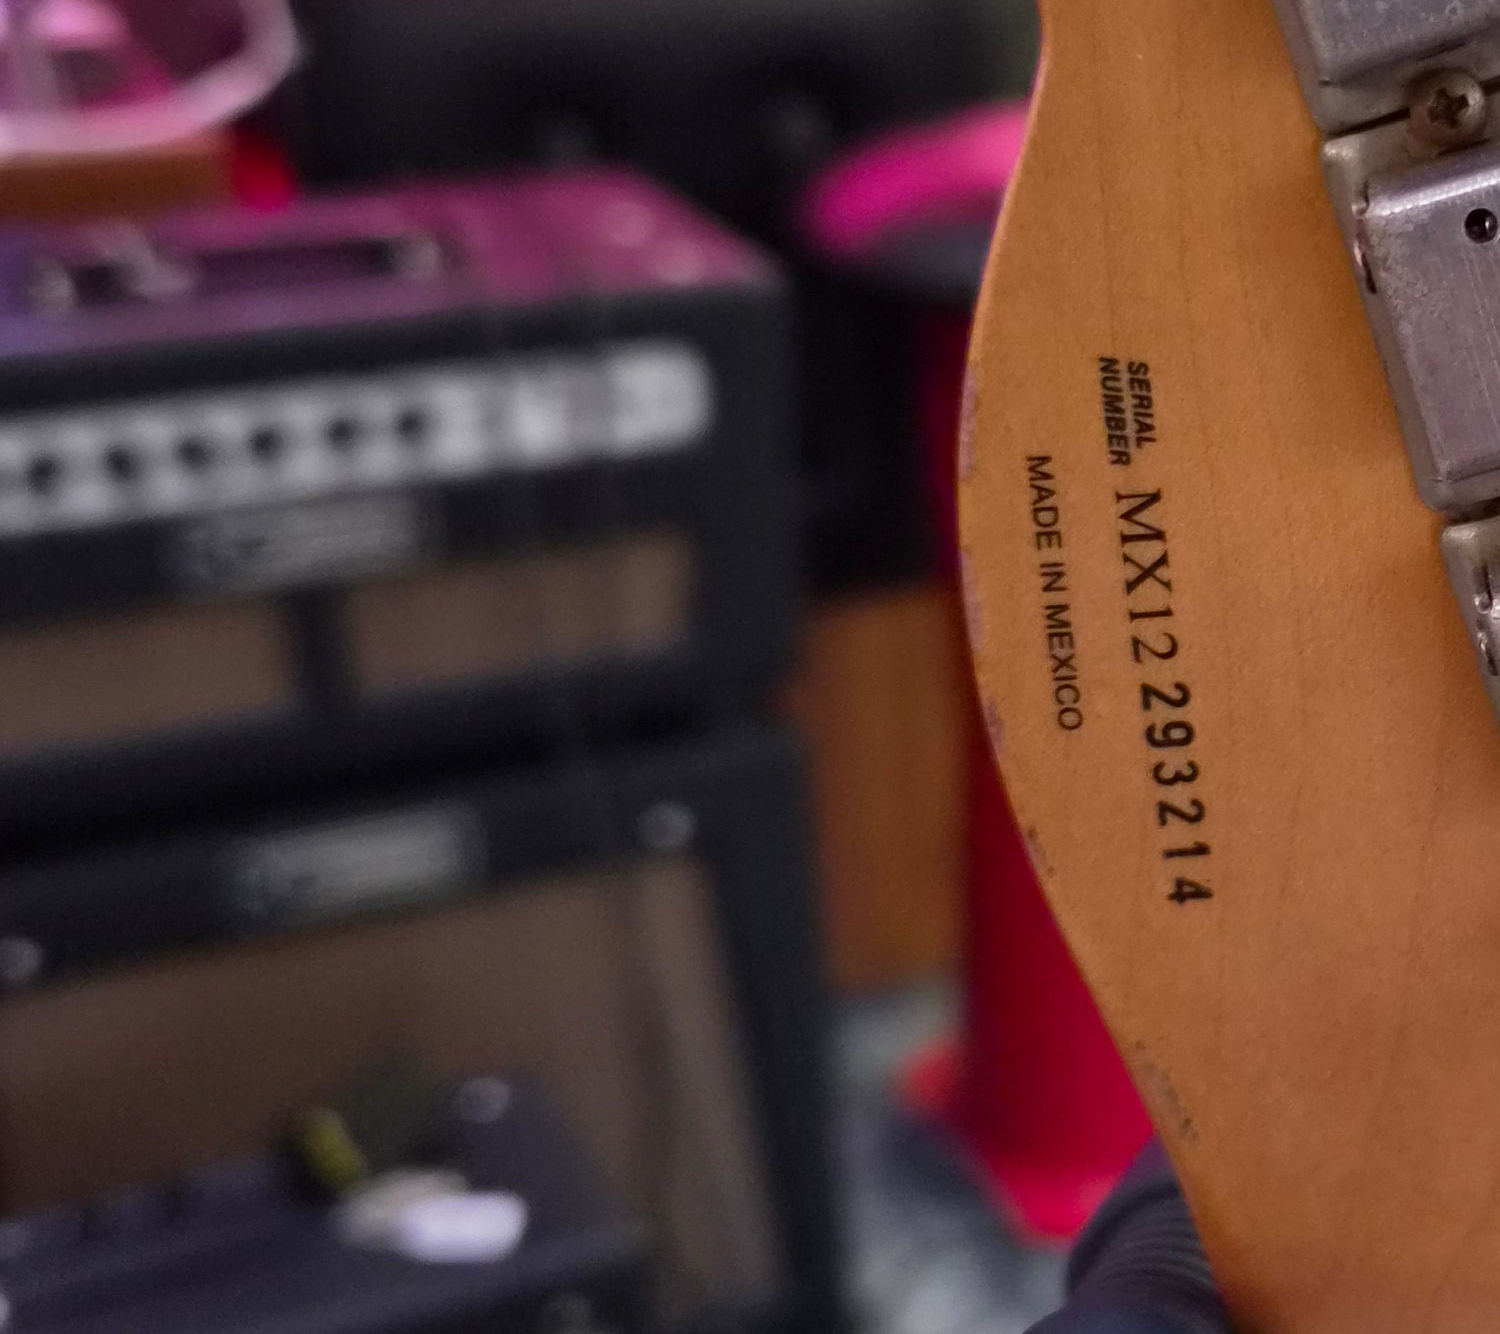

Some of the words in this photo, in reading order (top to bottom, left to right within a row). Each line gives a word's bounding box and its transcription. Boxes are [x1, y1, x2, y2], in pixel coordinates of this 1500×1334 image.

[1098, 356, 1132, 466] NUMBER
[1127, 360, 1157, 449] SERIAL
[1026, 455, 1063, 551] MADE
[1039, 561, 1068, 593] IN
[1043, 603, 1084, 732] MEXICO
